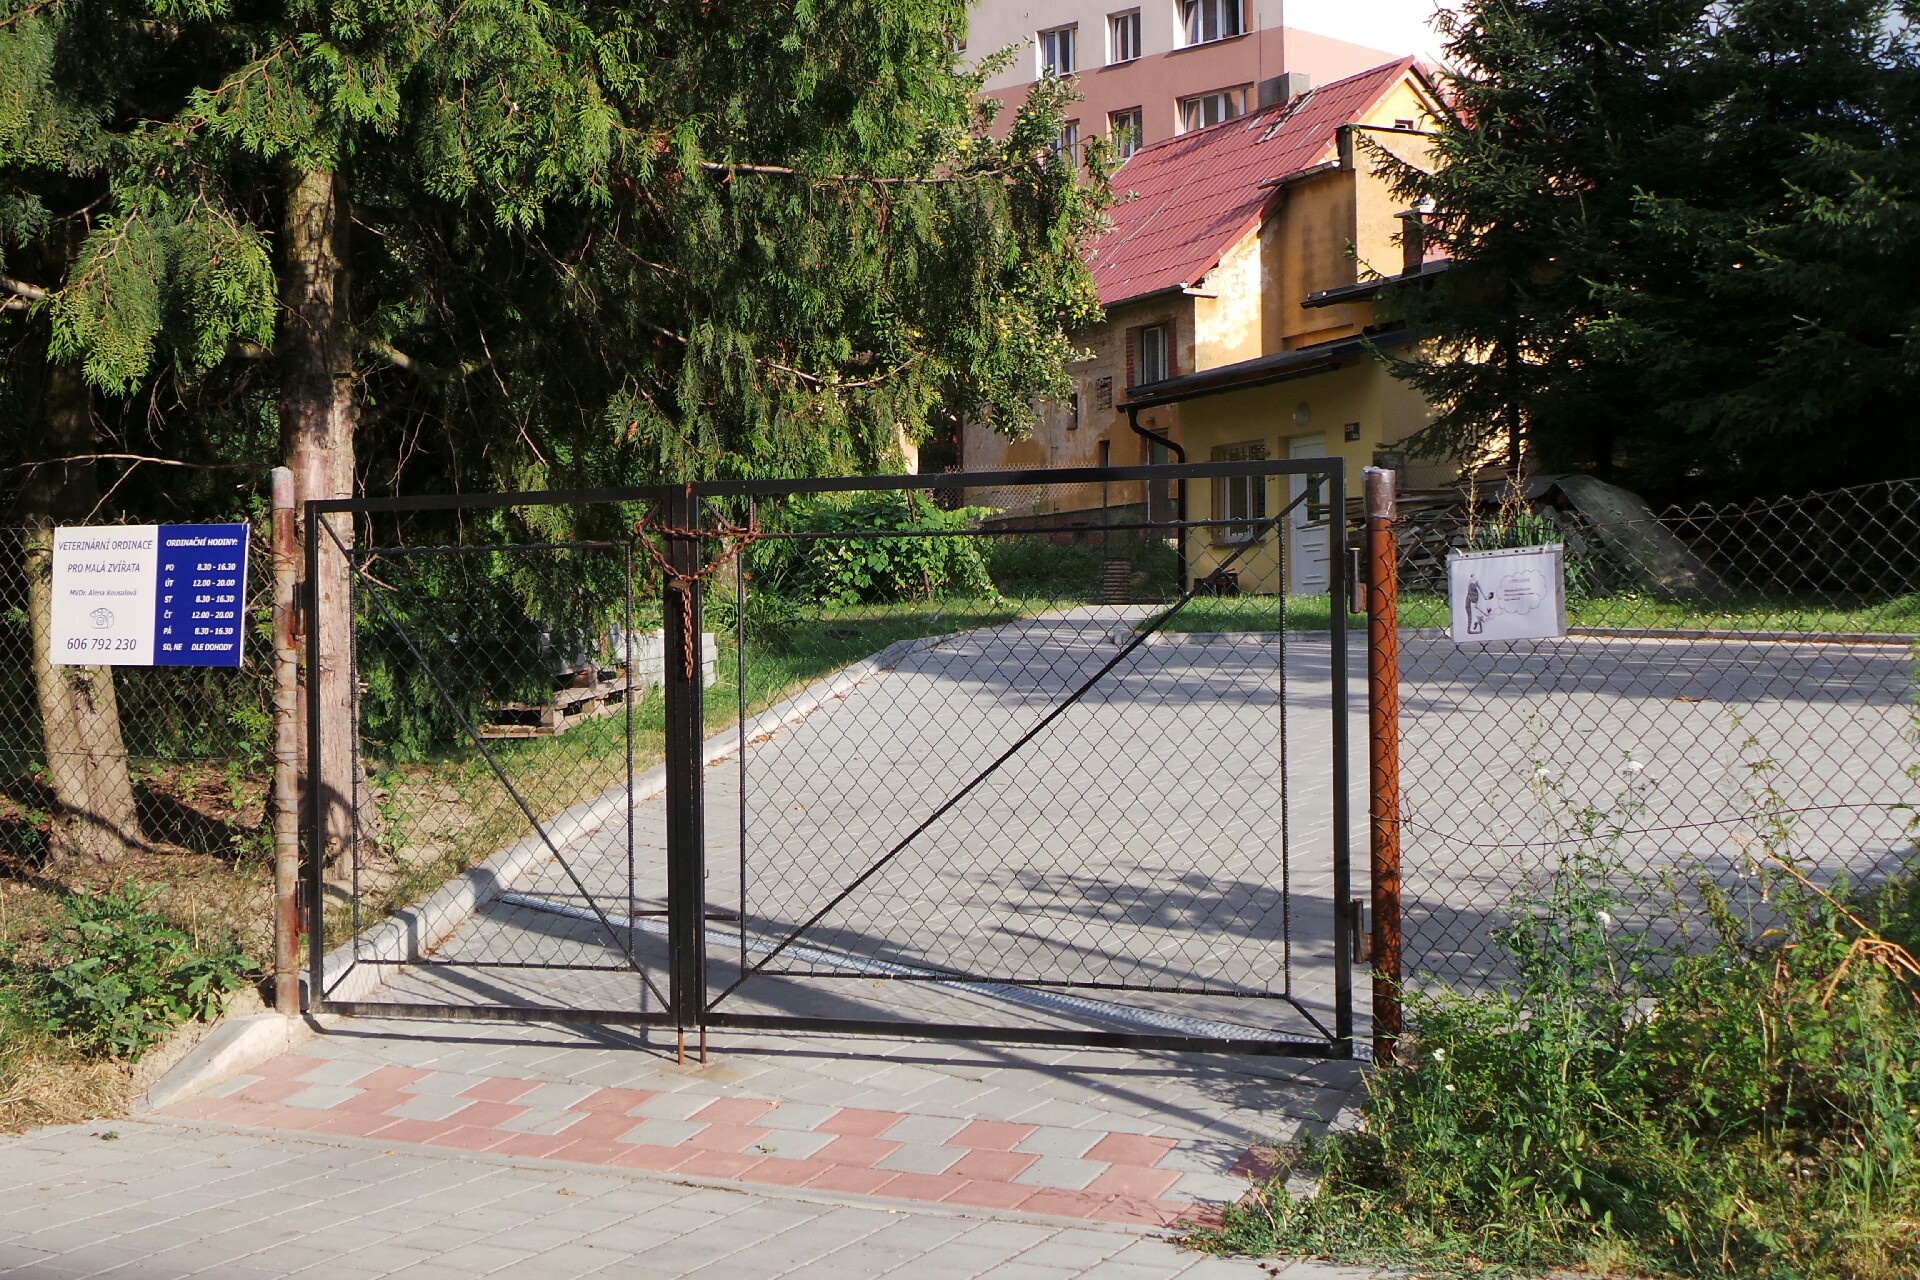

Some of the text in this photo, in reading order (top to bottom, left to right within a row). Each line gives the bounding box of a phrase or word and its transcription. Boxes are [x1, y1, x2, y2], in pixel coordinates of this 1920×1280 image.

[58, 538, 153, 550] VETERINÁRNÍ ORDINACE
[166, 536, 238, 547] ORDINAČNÍ HODINY:
[67, 560, 140, 573] PRO MALÁ ZVÍŘATA
[165, 563, 175, 571] PO
[196, 563, 212, 571] 8.30
[217, 563, 236, 571] 16.30
[164, 577, 174, 587] ÚT
[192, 579, 211, 587] 12.00
[216, 579, 236, 587] 20.00
[164, 595, 173, 603] ST
[195, 595, 210, 603] 8.30
[216, 595, 235, 603] 16.30
[163, 609, 173, 619] ČT
[191, 611, 210, 619] 12.00
[215, 611, 234, 619] 20.00
[163, 625, 172, 635] PÁ
[194, 627, 209, 635] 8.30
[214, 627, 234, 635] 16.30
[66, 637, 137, 651] 606 792 230
[173, 643, 183, 651] NE
[191, 643, 204, 651] DLE
[204, 643, 234, 651] DOHODY
